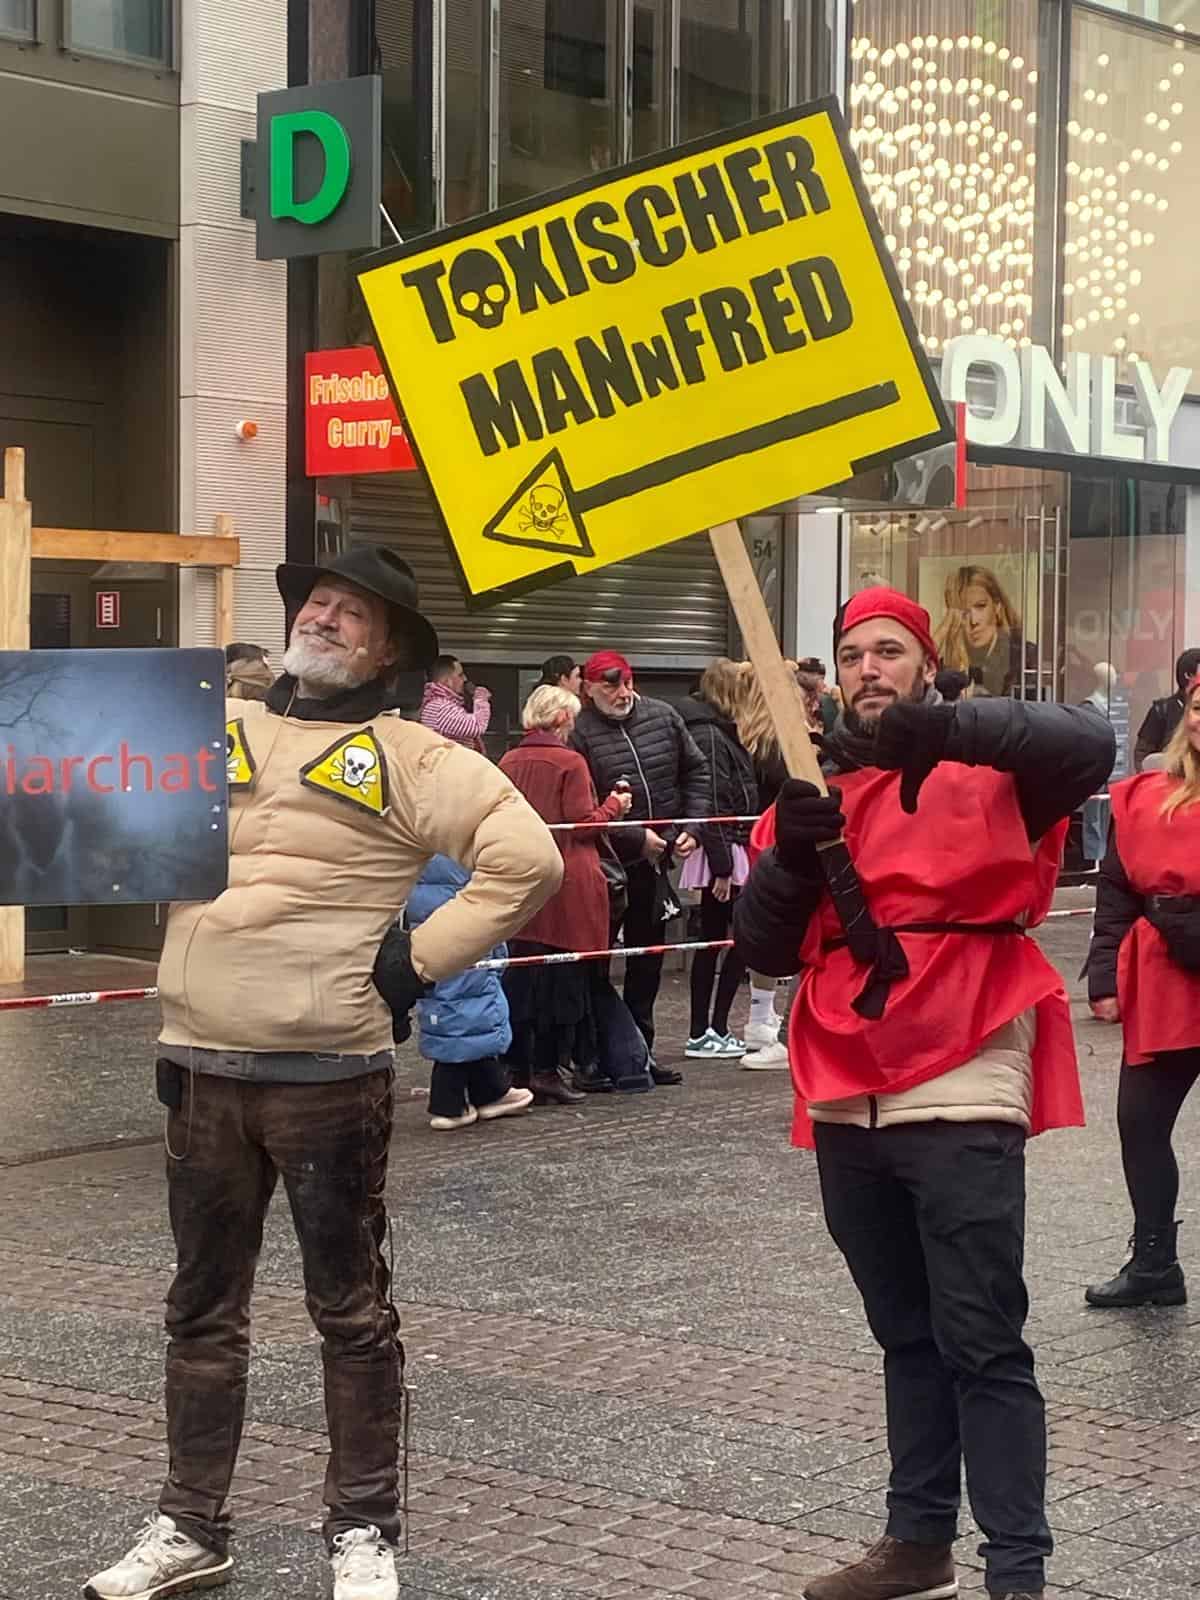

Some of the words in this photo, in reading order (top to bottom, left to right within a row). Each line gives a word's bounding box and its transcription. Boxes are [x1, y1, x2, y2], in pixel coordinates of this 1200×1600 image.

[271, 110, 350, 224] D
[310, 371, 389, 405] Frische
[942, 335, 1192, 463] ONLY
[328, 417, 409, 448] Curry-
[0, 741, 217, 794] iarchat
